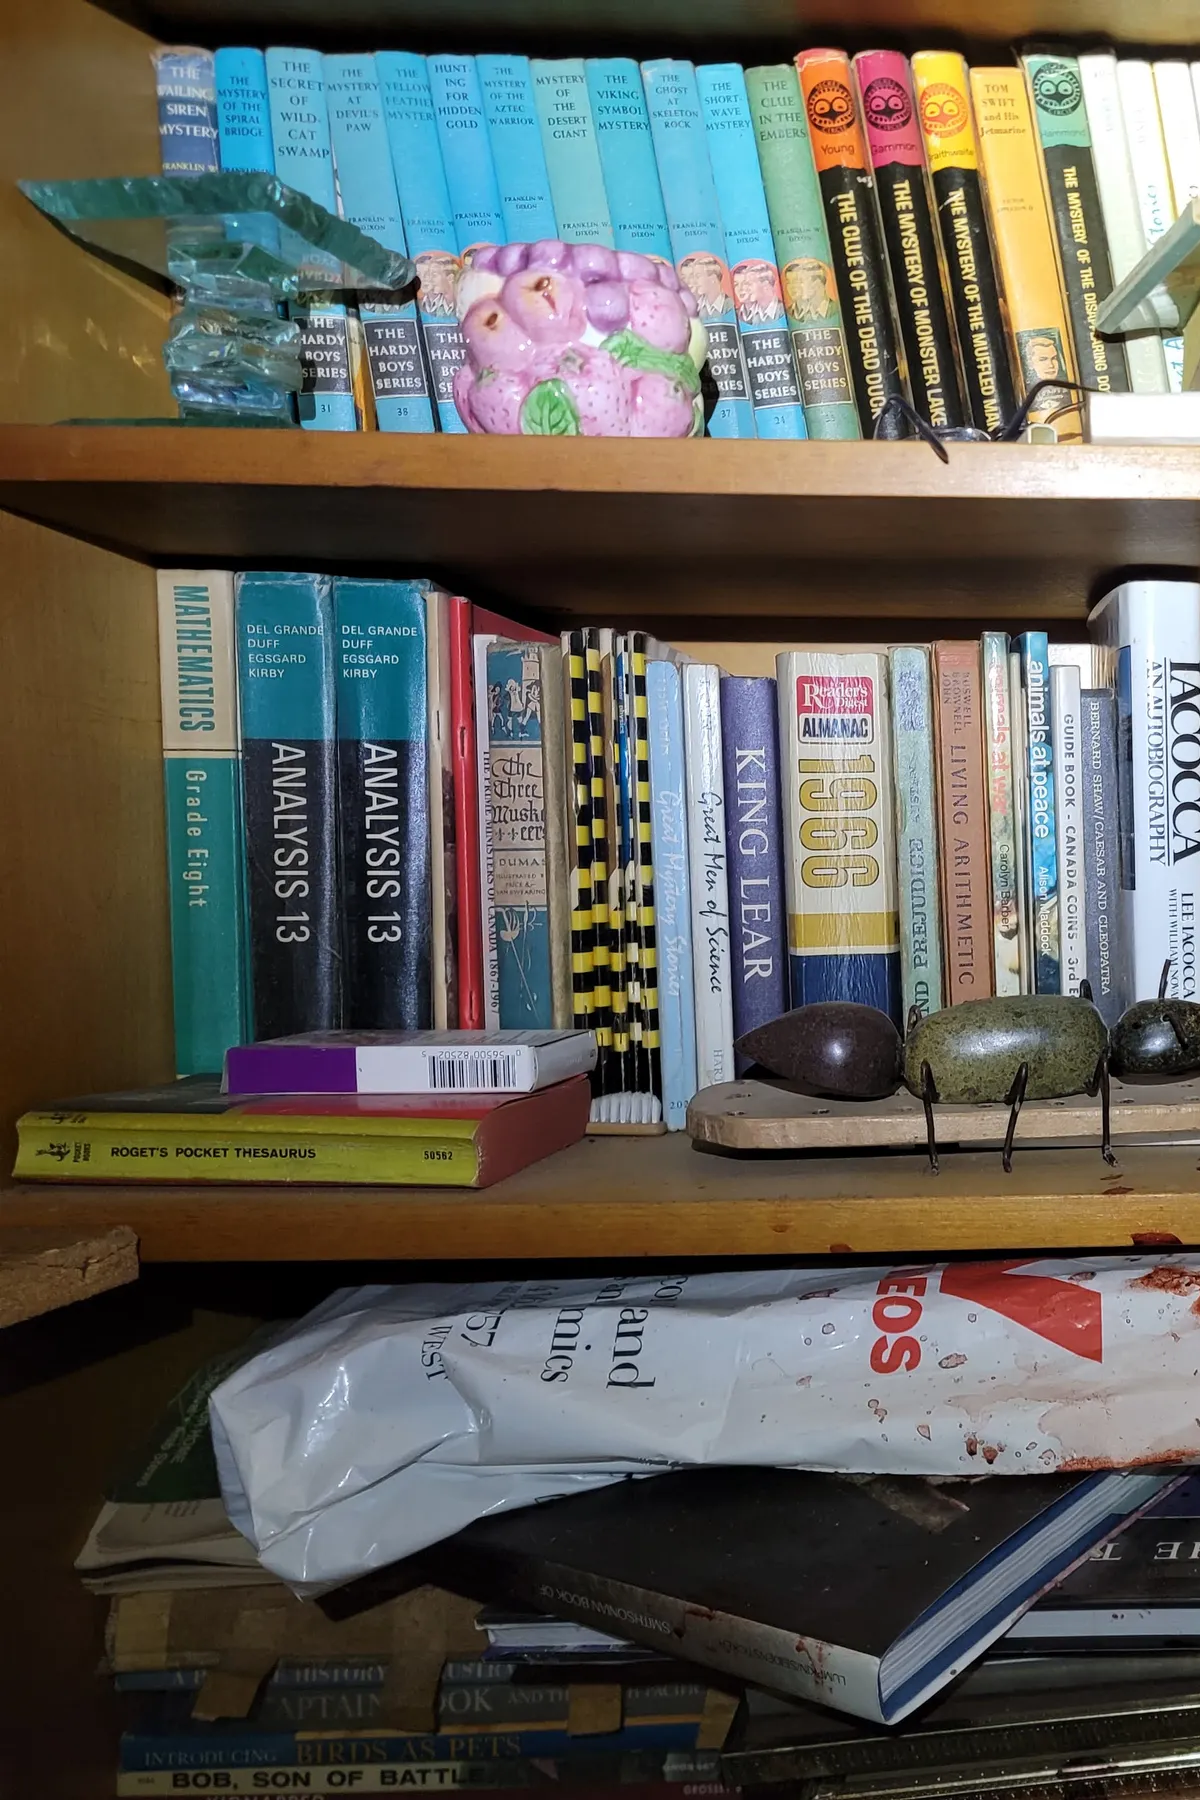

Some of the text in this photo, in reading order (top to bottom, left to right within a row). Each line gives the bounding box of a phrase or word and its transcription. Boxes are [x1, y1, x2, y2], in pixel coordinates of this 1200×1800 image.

[282, 61, 311, 74] THE
[271, 77, 323, 90] SECRET
[445, 78, 465, 87] ING
[536, 75, 584, 85] MYSTERY
[604, 75, 628, 84] THE
[711, 82, 731, 91] THE
[446, 92, 468, 101] FOR
[556, 89, 570, 98] OF
[597, 90, 639, 100] VIKING
[290, 95, 309, 105] OF
[439, 107, 482, 116] HIDDEN
[554, 103, 575, 111] THE
[598, 105, 644, 115] SYMBOL
[710, 107, 741, 117] WAVE
[446, 120, 478, 129] GOLD
[548, 116, 587, 126] DESERT
[599, 120, 649, 130] MYSTERY
[705, 120, 750, 130] MYSTERY
[288, 129, 317, 141] CAT
[552, 129, 587, 138] GIANT
[278, 146, 330, 159] SWAMP
[821, 143, 855, 157] Young
[842, 226, 862, 267] CLUE
[898, 215, 940, 385] MYSTERY MONSTER
[375, 328, 405, 339] THE
[369, 345, 417, 356] HARDY
[378, 362, 414, 372] BOYS
[376, 377, 421, 389] SERIES
[397, 408, 408, 416] 38
[247, 624, 324, 635] DEL GRANDE
[342, 625, 418, 636] DEL GRANDE
[248, 639, 279, 648] DUFF
[342, 639, 373, 649] DUFF
[173, 585, 216, 734] MATHEMATICS
[248, 654, 306, 664] EGSGARD
[343, 654, 399, 664] EGSGARD
[249, 668, 284, 678] KIRBY
[343, 668, 377, 678] KIRBY
[802, 682, 868, 708] Reader's
[803, 716, 868, 740] ALMANAC
[1090, 702, 1100, 769] BERNARD
[1146, 692, 1167, 865] AUTOBIOGRAPHY
[1026, 661, 1049, 956] animals at peace Alison Maddock
[699, 789, 722, 845] Great
[798, 753, 880, 889] 1966
[1064, 714, 1078, 942] GUIDE BOOK CANADA COINS
[182, 770, 209, 908] Grade Eight
[271, 742, 309, 944] ANALYSIS 13
[363, 742, 401, 943] ANALYSIS 13
[704, 849, 728, 891] Men
[735, 745, 773, 984] KING LEAR
[950, 745, 974, 986] LIVING ARITHMETIC
[999, 844, 1011, 930] Carolyn Barber
[1097, 879, 1106, 909] AND
[699, 896, 719, 922] of
[910, 838, 928, 970] PREJUDICE
[1182, 892, 1196, 999] LEE IACOCCA
[706, 927, 728, 994] Science
[1099, 914, 1112, 996] CLEOPATRA
[438, 1050, 505, 1060] 82502 56500
[111, 1146, 453, 1161] ROGET'S POCKET THESAURUS 50562
[420, 1324, 454, 1381] WEST
[145, 1736, 522, 1767] INTRODUCING BIRDS AS PETS
[172, 1767, 481, 1790] BOB, SON OF BATTLE
